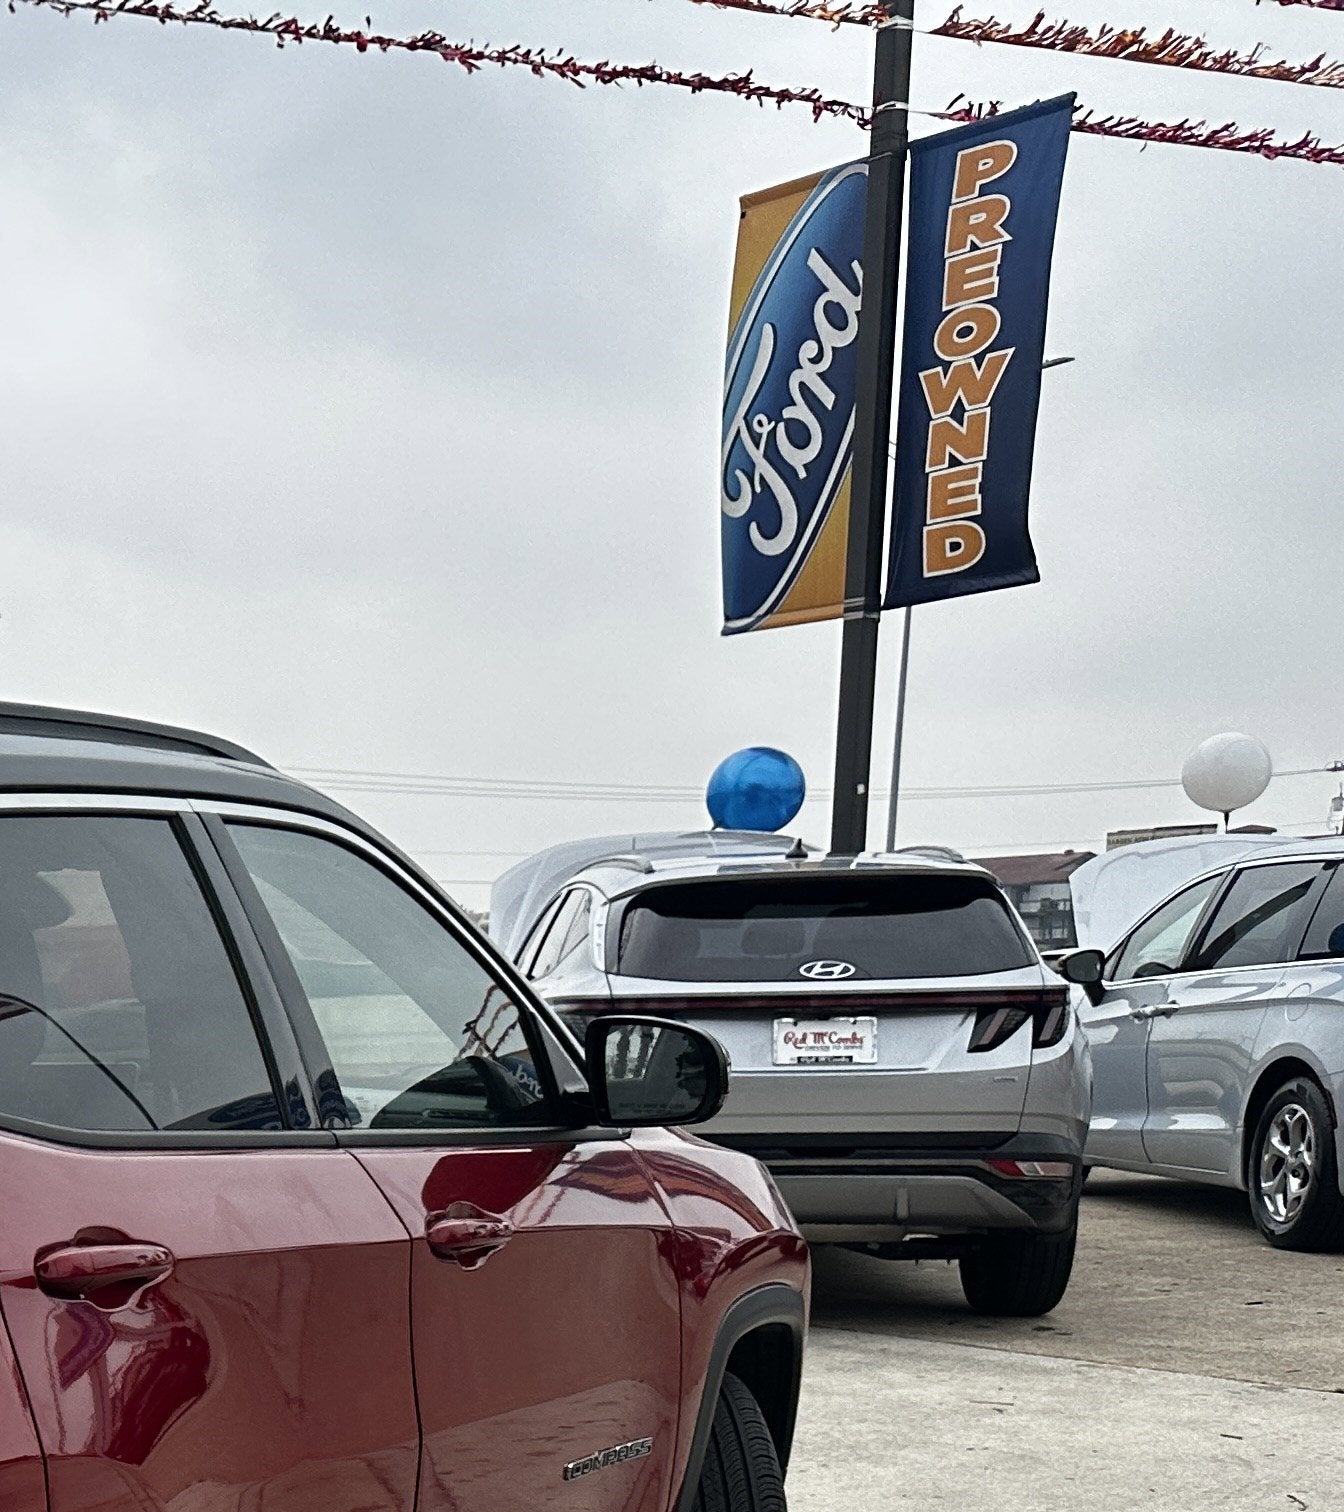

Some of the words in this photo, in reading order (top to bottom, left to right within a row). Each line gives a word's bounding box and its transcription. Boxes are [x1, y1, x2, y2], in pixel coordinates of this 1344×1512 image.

[722, 247, 863, 556] Ford
[918, 138, 1017, 578] PREOWNED
[563, 1436, 653, 1480] COMPASS
